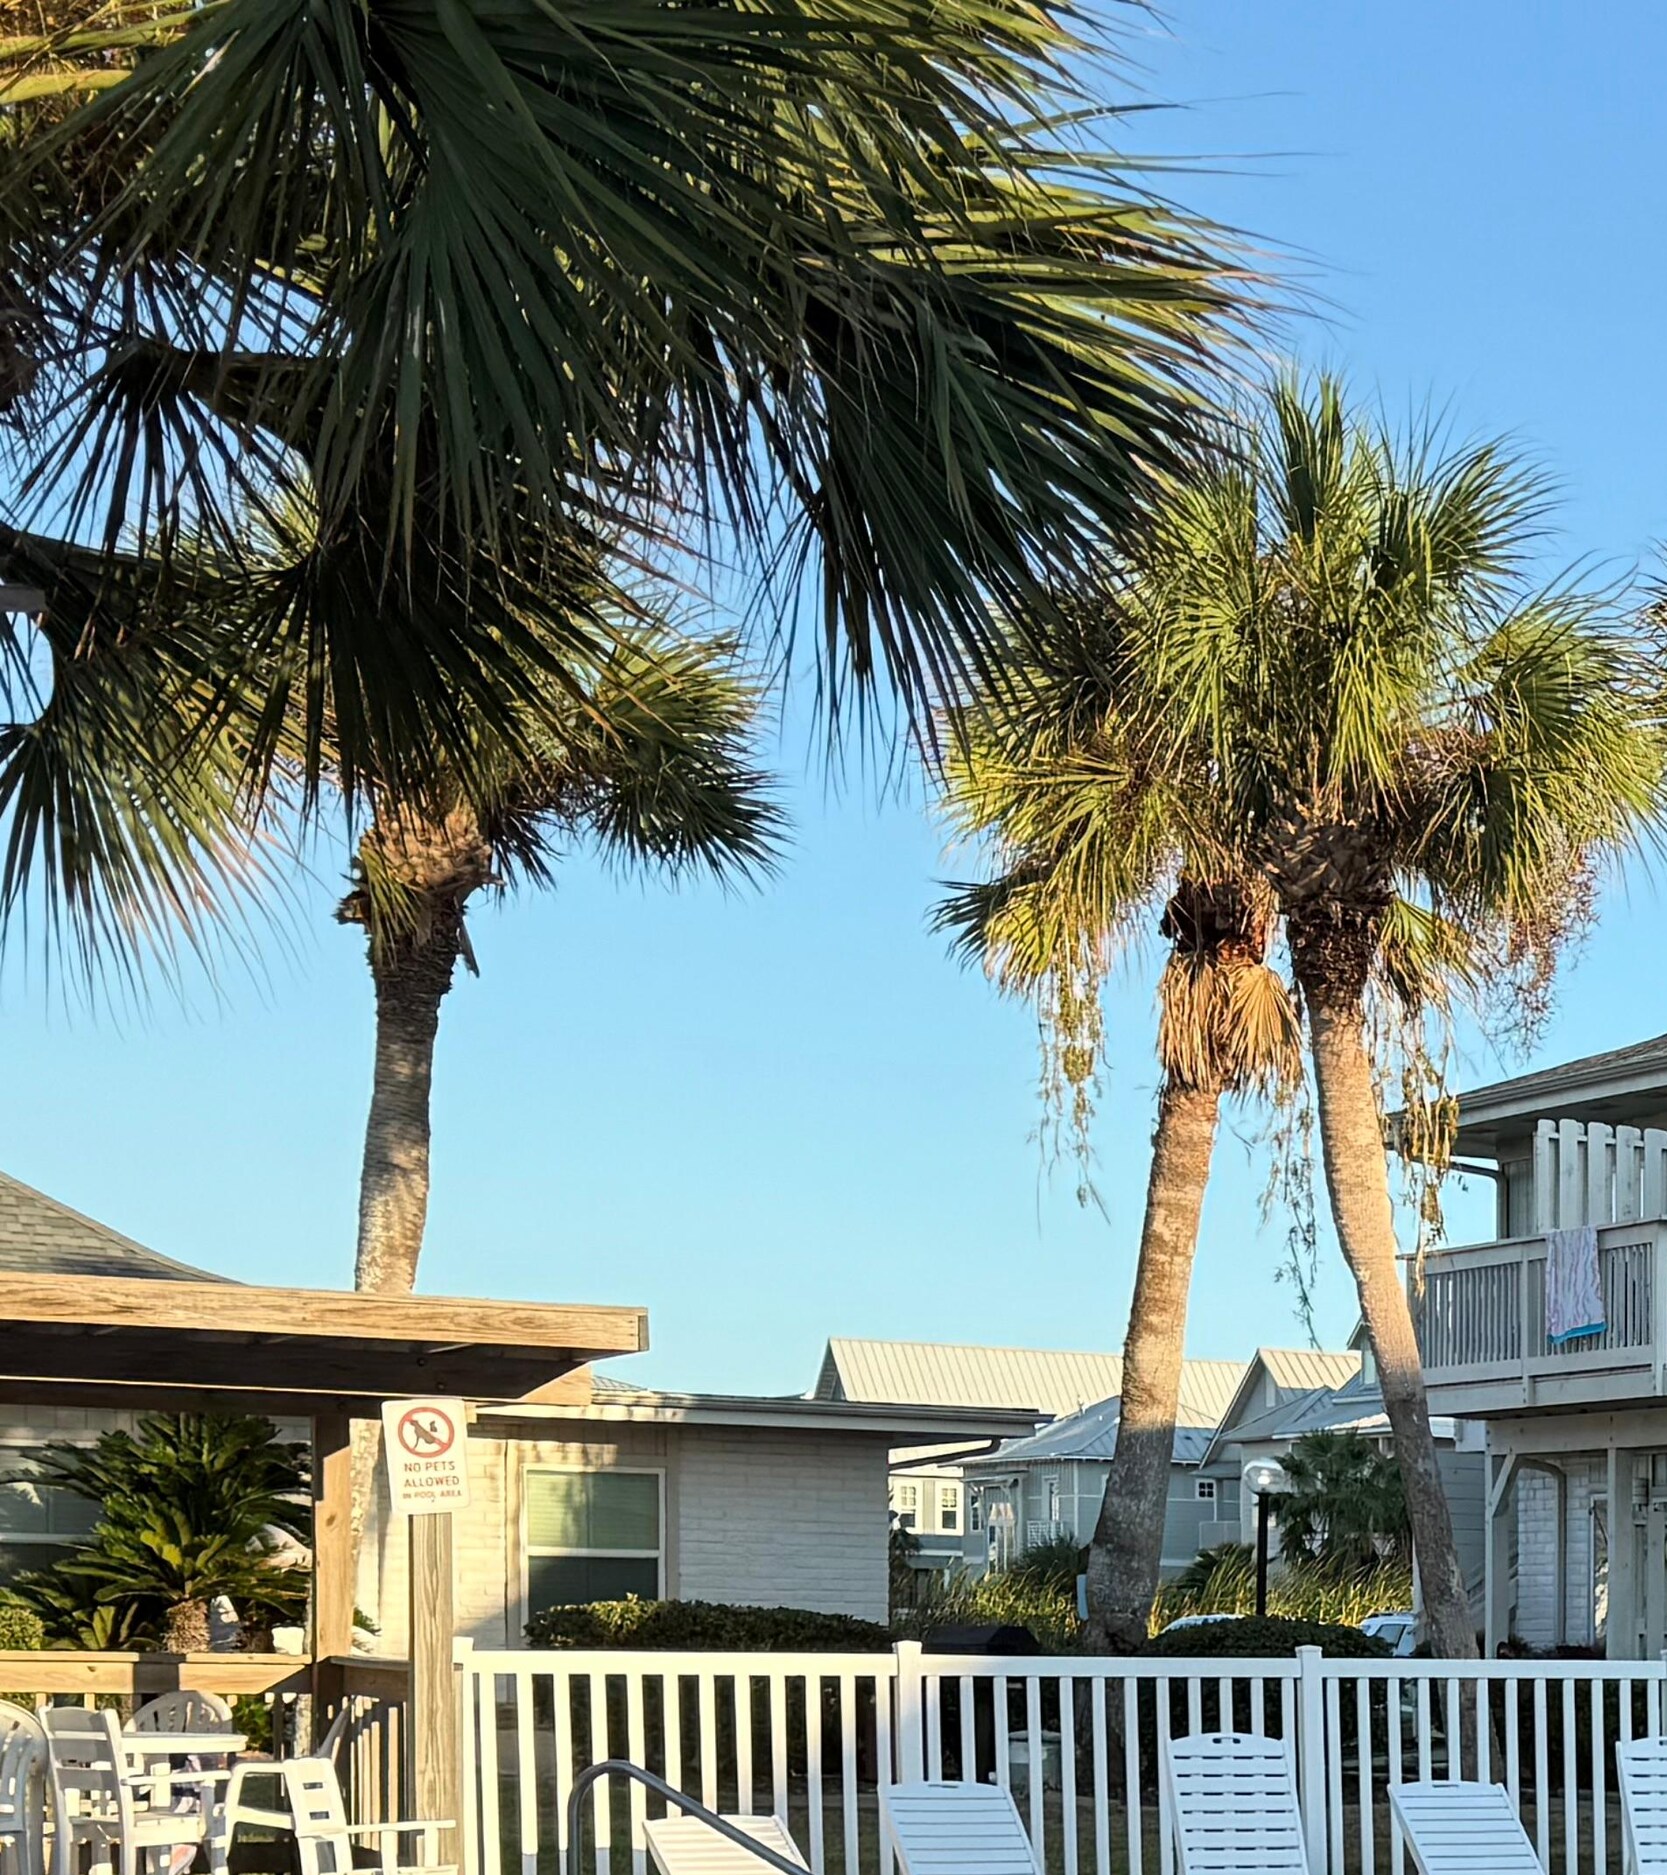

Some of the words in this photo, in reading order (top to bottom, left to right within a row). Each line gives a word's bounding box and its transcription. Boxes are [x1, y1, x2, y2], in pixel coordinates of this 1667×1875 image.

[404, 1462, 421, 1473] NO
[425, 1460, 456, 1471] PETS
[404, 1475, 460, 1488] ALLOWED
